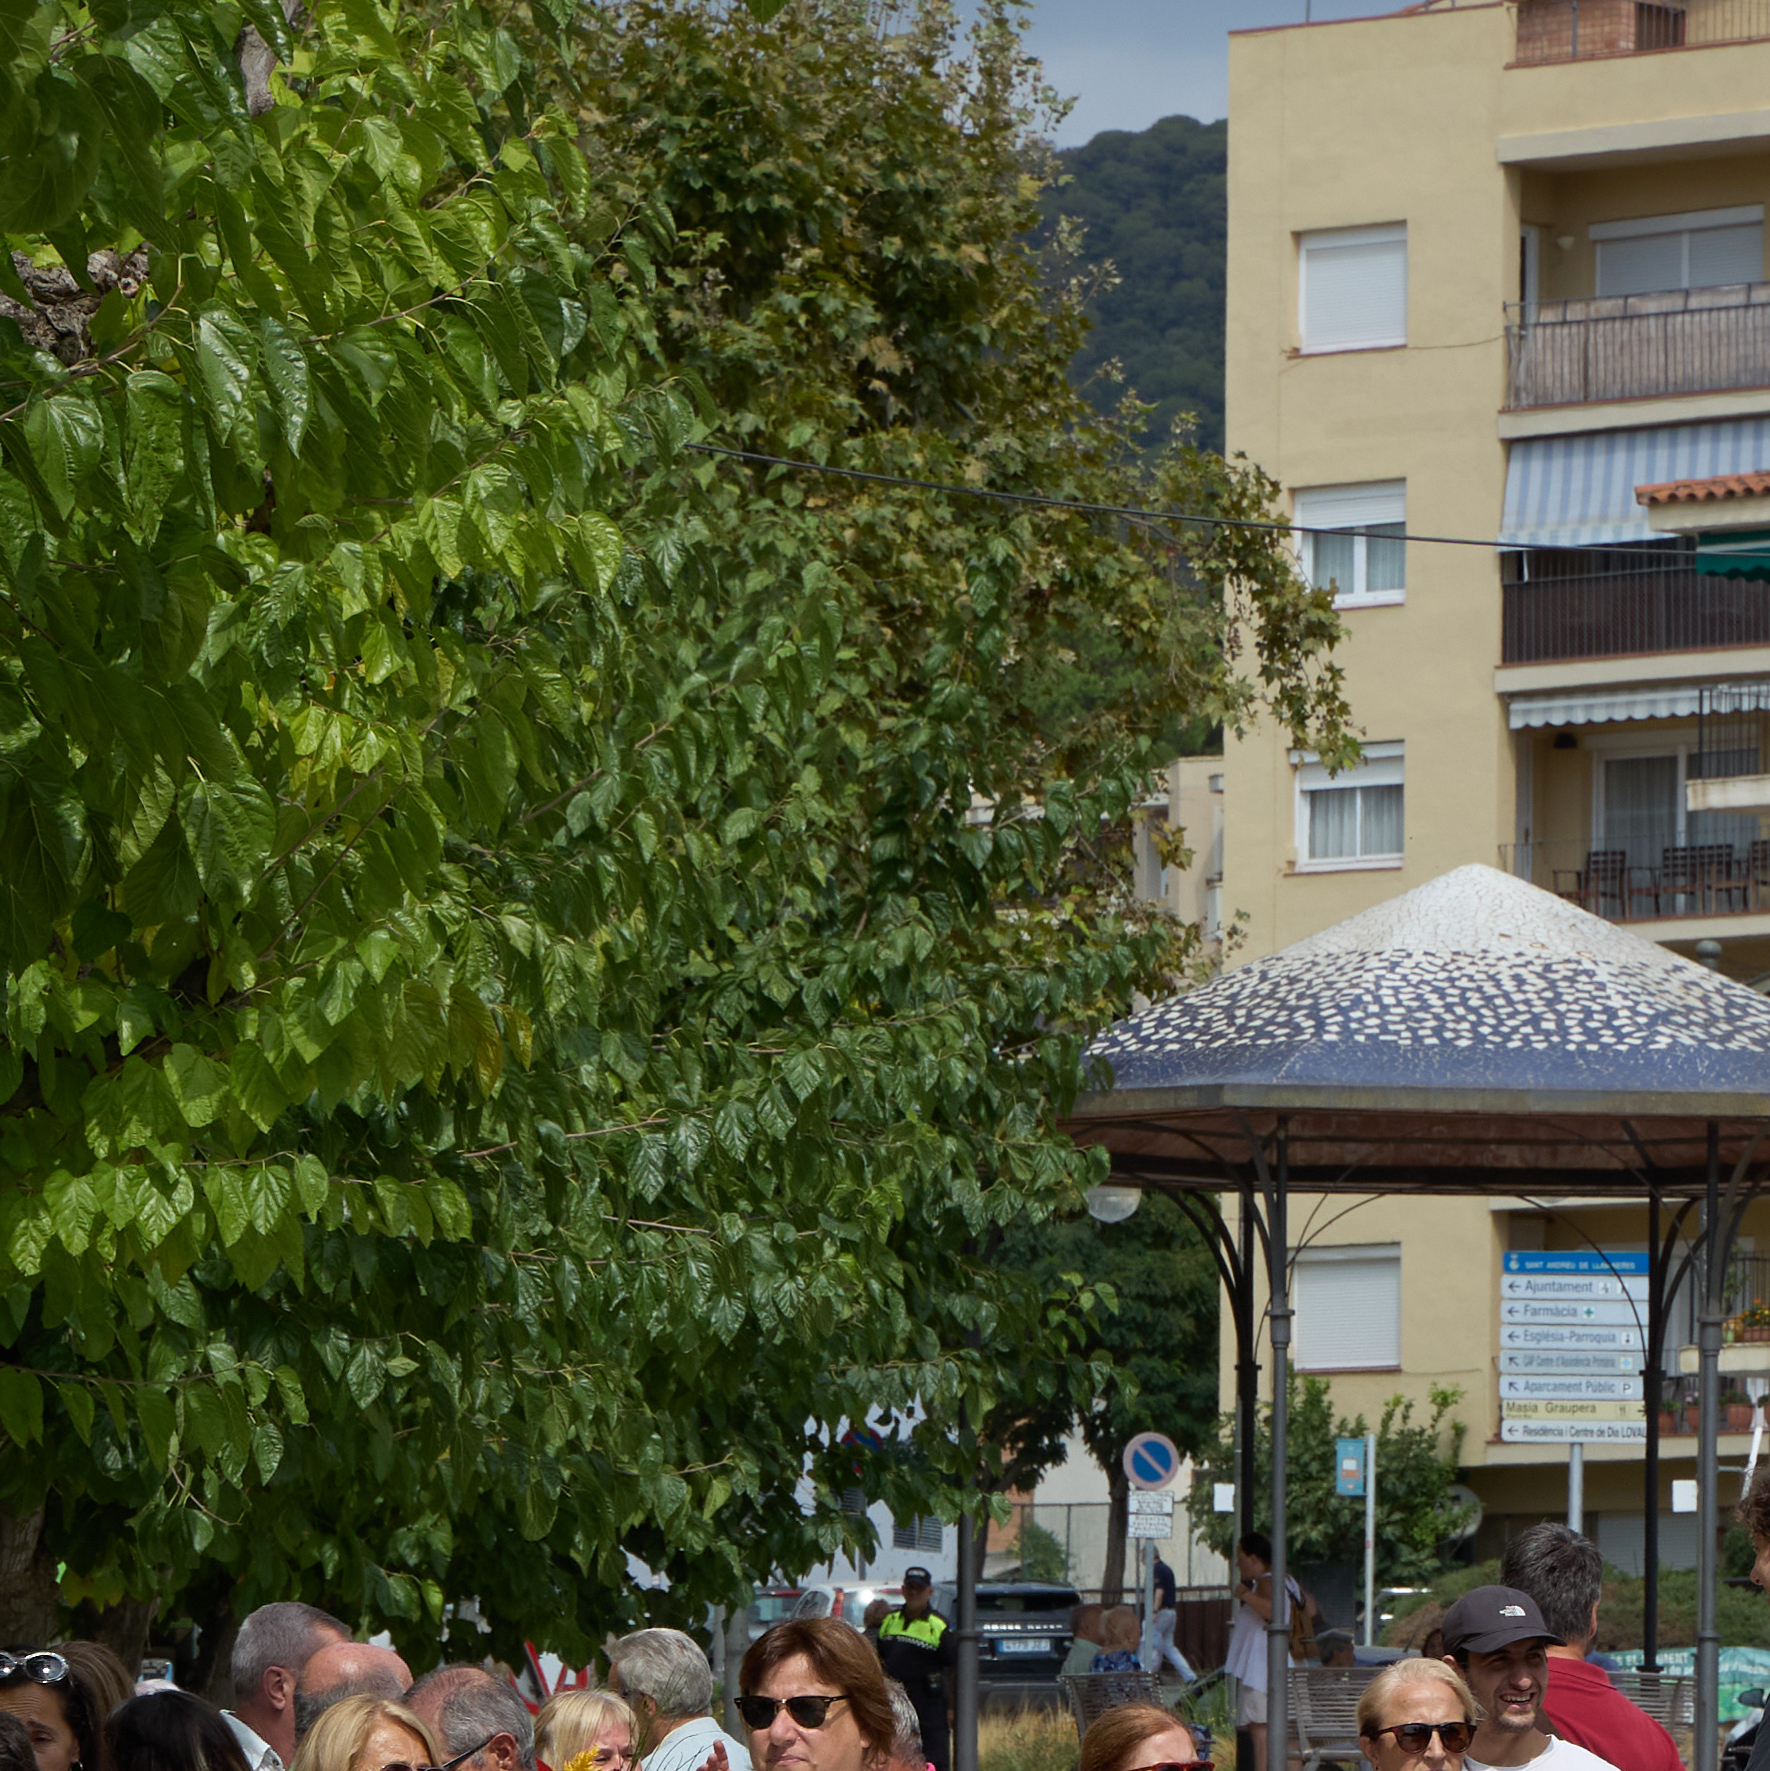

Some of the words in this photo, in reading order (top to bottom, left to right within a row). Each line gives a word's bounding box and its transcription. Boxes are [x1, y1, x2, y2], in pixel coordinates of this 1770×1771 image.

[1579, 1261, 1589, 1269] DE
[1525, 1280, 1593, 1294] Ajuntament
[1523, 1304, 1578, 1318] Farmàcia
[1523, 1381, 1583, 1395] Aparcament
[1505, 1402, 1539, 1414] Masia
[1545, 1402, 1597, 1415] Graupera
[1569, 1426, 1595, 1438] Centre
[1596, 1426, 1606, 1438] de
